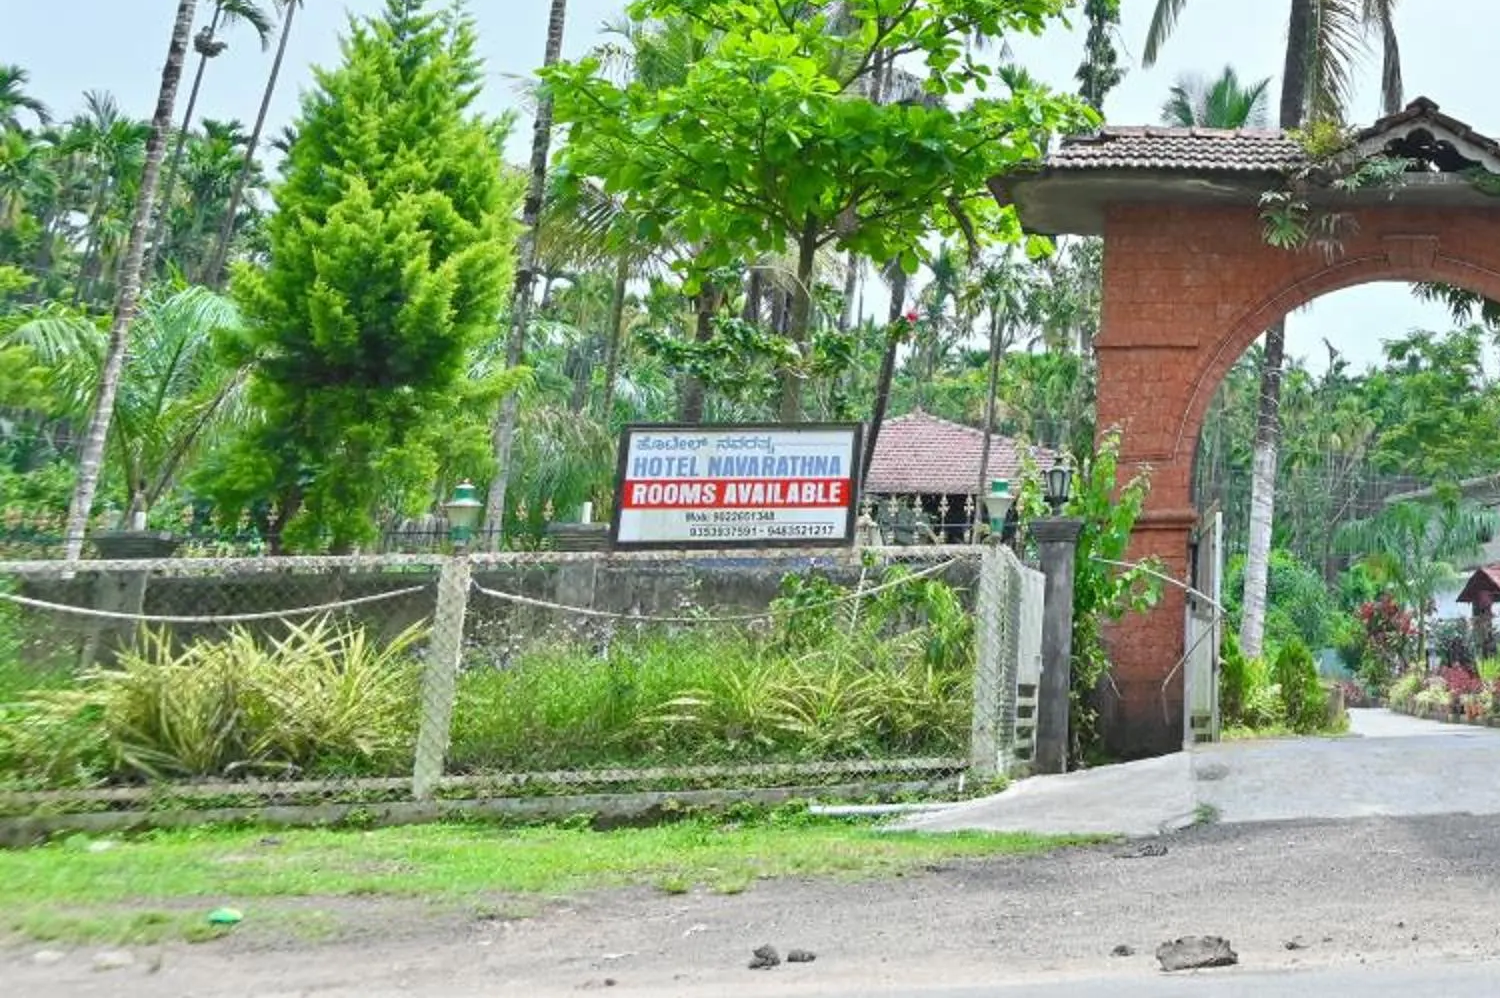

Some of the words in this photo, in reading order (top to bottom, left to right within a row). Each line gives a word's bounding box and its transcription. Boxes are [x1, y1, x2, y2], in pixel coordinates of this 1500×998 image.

[633, 456, 699, 477] HOTEL
[708, 455, 841, 477] NAVARATHNA
[631, 483, 716, 505] ROOMS
[723, 481, 842, 504] AVAILABLE
